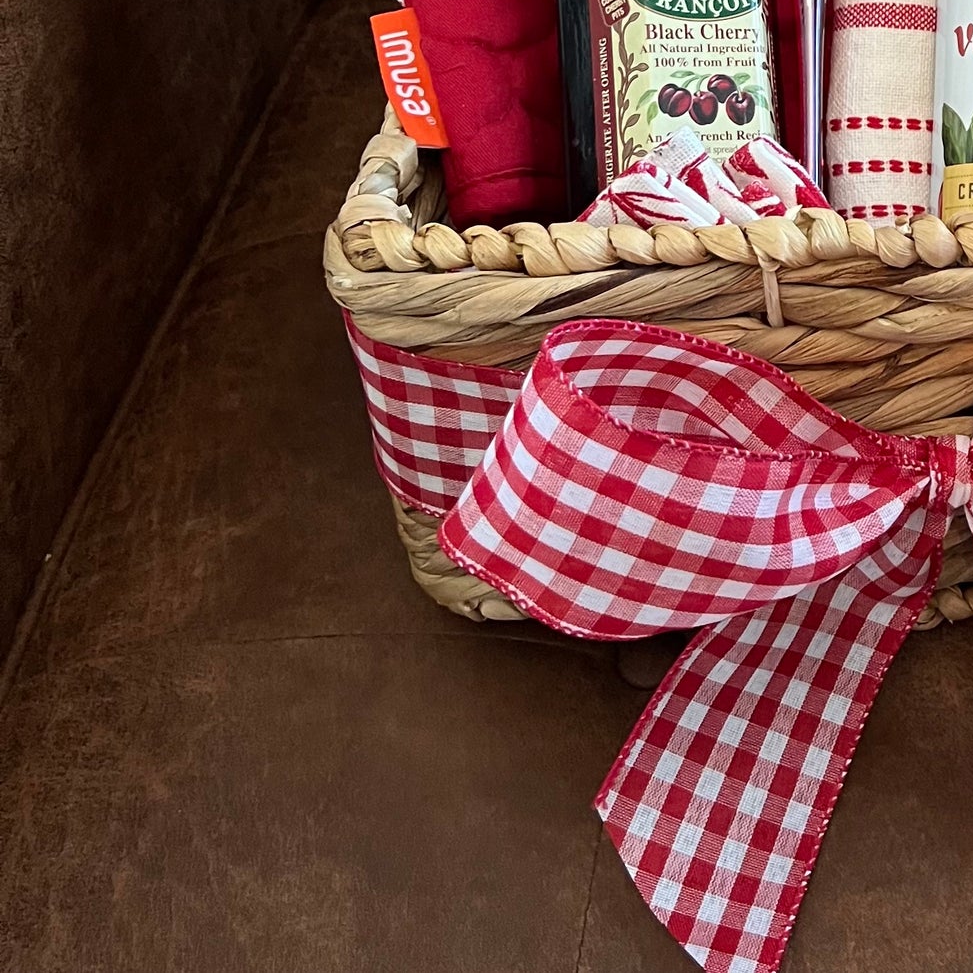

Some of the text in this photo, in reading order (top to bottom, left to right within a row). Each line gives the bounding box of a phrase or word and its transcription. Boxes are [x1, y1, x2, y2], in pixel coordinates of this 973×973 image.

[611, 7, 625, 21] PITS
[645, 23, 760, 43] Black Cherry
[640, 44, 656, 54] All
[660, 44, 703, 54] Natural
[655, 57, 757, 68] 100% from Fruit
[599, 37, 615, 186] RIGERATE AFTER OPENING
[645, 133, 663, 144] An
